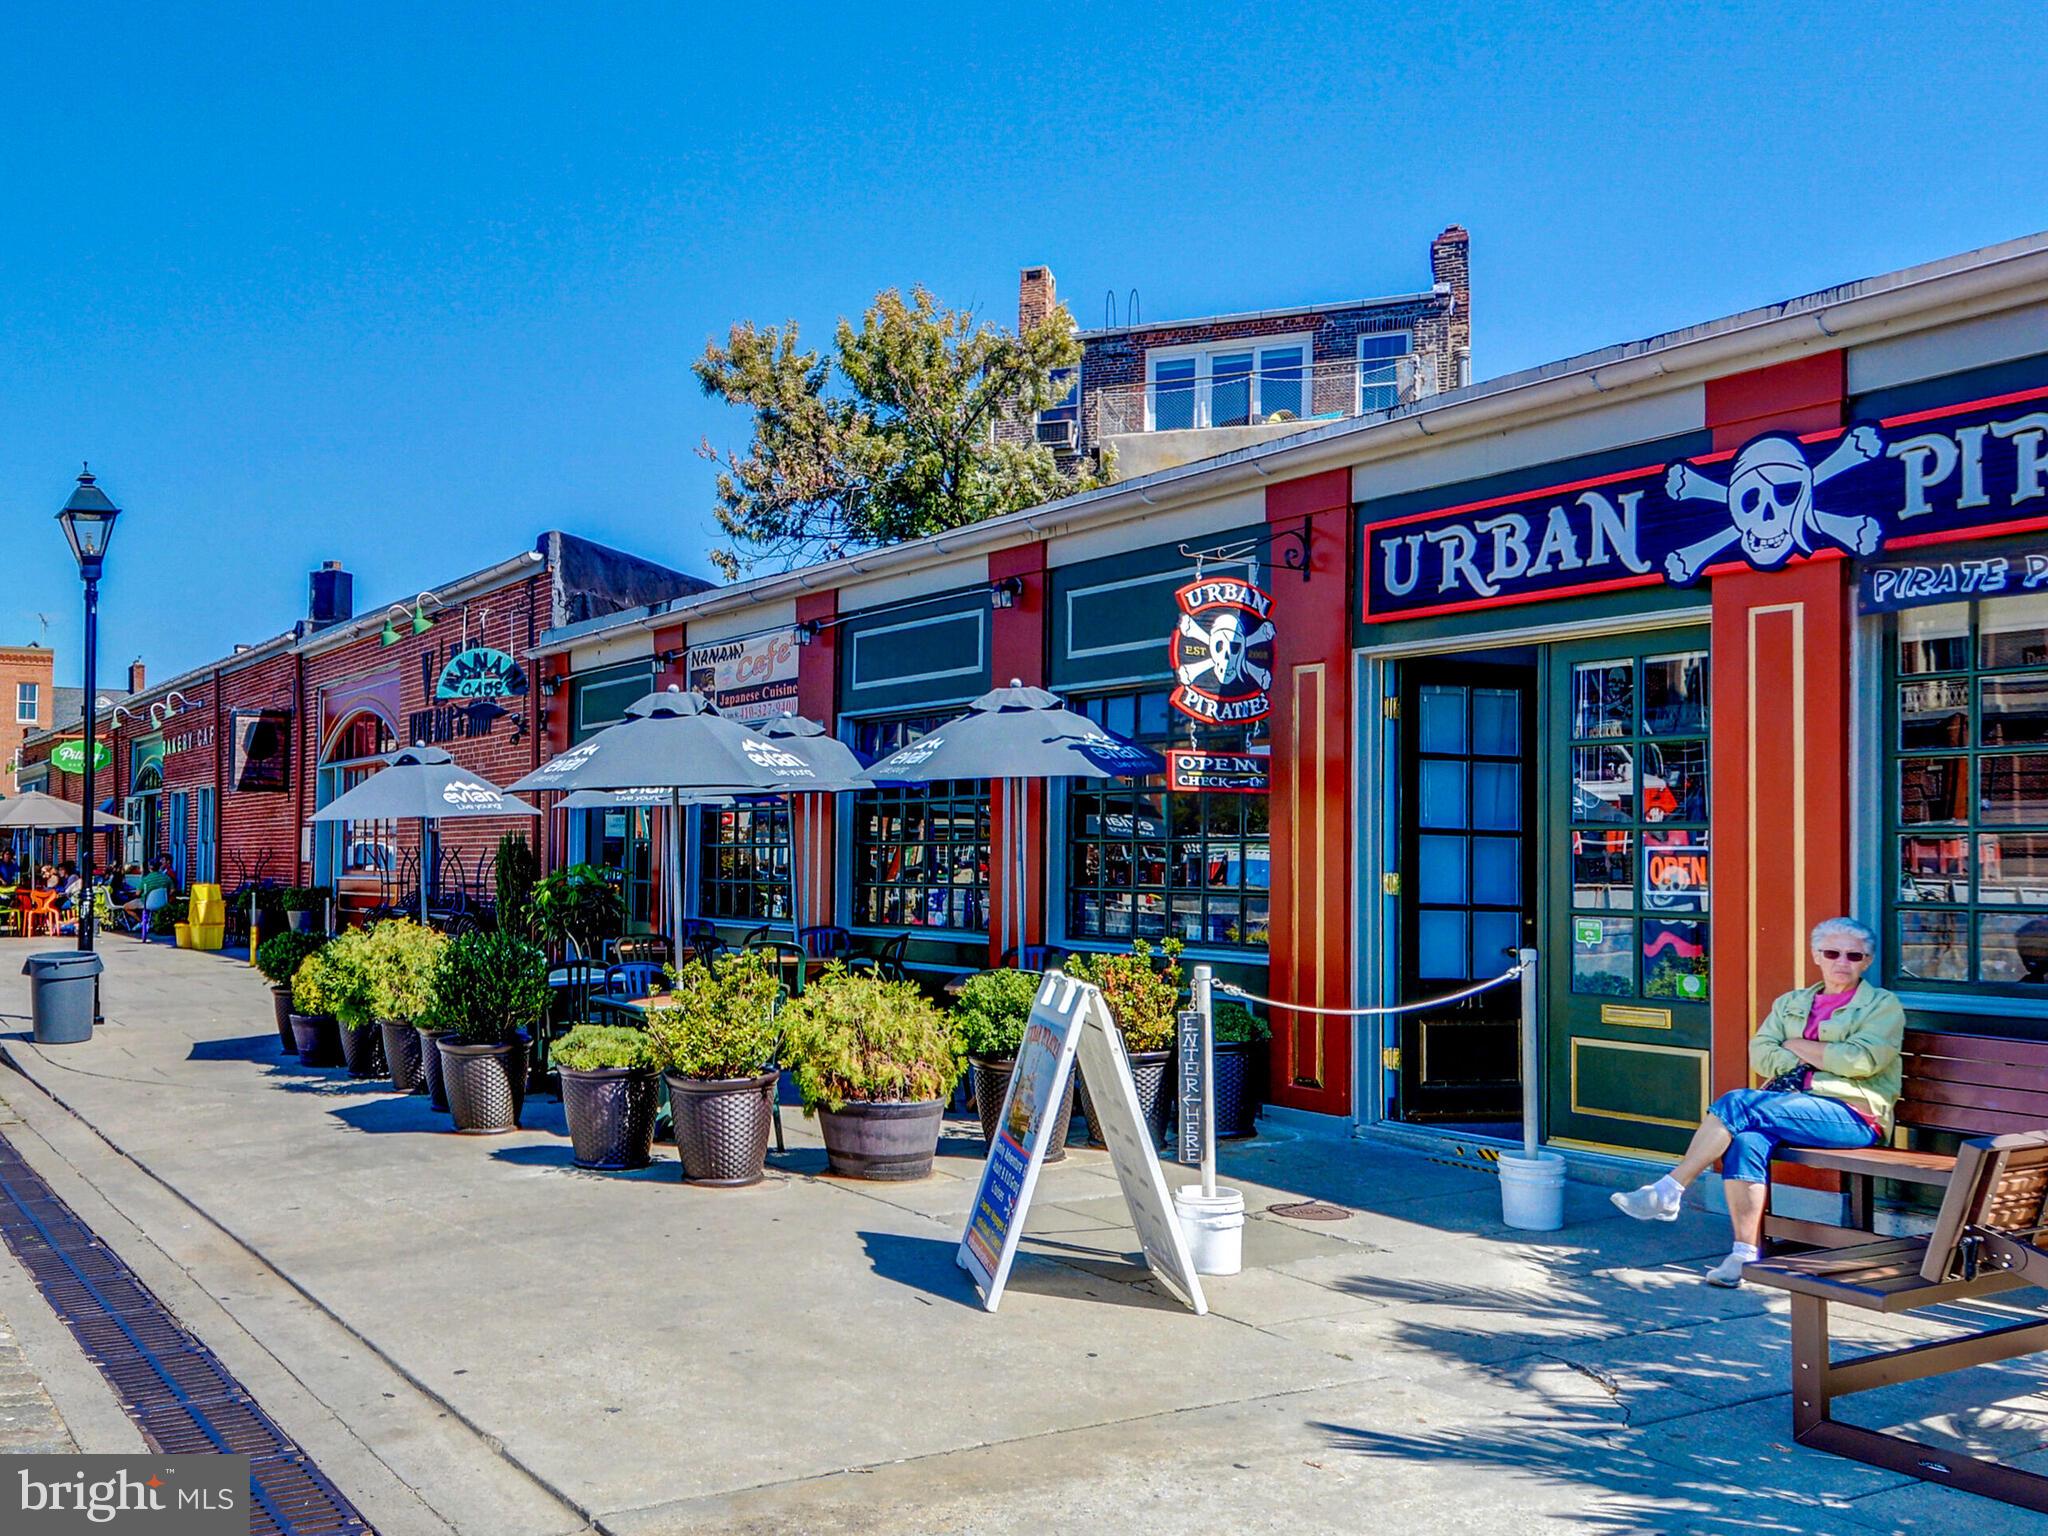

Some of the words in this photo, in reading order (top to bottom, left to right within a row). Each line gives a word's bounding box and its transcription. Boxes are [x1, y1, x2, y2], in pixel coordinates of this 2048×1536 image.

[1380, 490, 1651, 597] URBAN
[1874, 558, 2009, 603] PIRATE
[1185, 583, 1270, 618] URBAN
[691, 643, 744, 668] NANAMI
[1185, 646, 1207, 656] EST
[719, 690, 760, 707] Japanese
[762, 683, 798, 700] Cuisine
[1183, 686, 1270, 721] PIRATES
[748, 750, 809, 767] evian
[443, 789, 504, 804] evian
[1650, 856, 1706, 886] OPEN
[1182, 1016, 1200, 1093] ENTER
[1185, 1108, 1201, 1162] HERE
